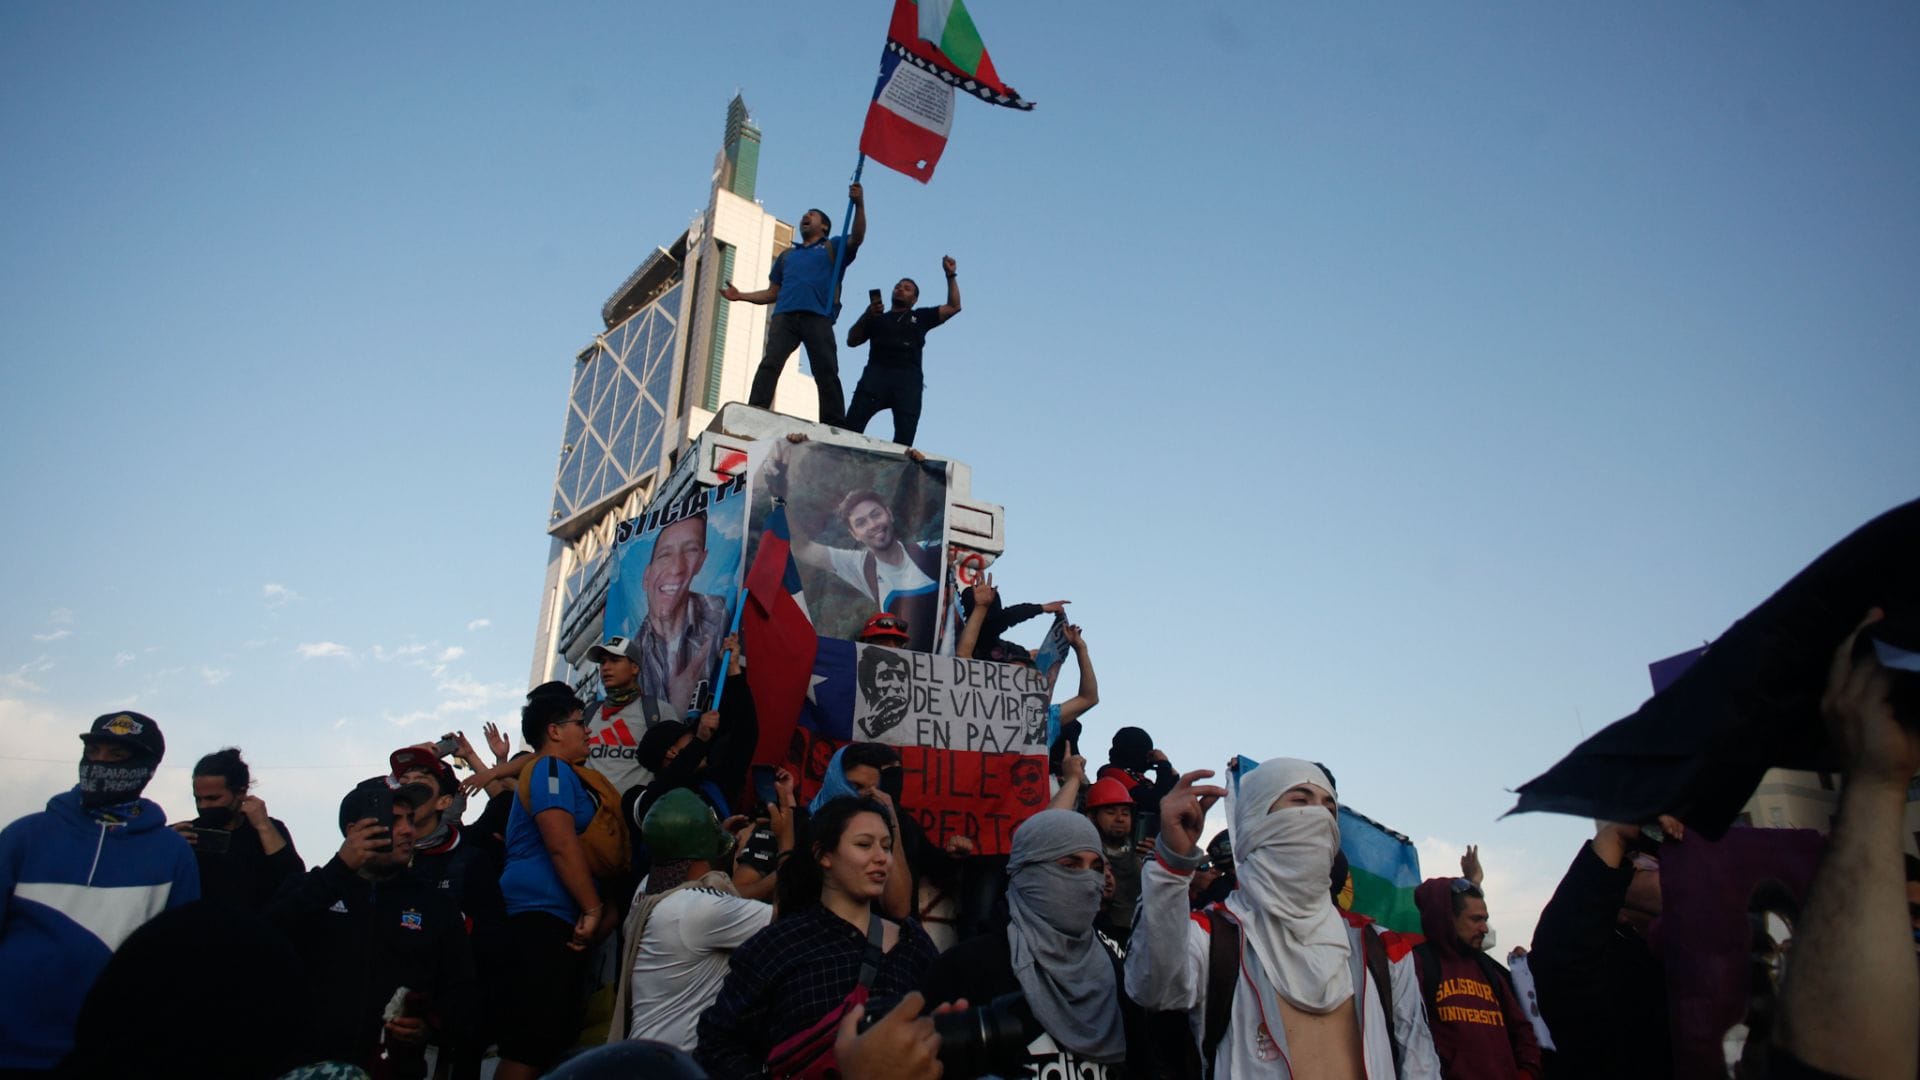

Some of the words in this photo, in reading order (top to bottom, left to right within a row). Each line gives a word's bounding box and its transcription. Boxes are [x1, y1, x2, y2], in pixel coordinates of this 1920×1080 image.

[613, 489, 710, 549] STICIA
[912, 652, 943, 684] EL
[952, 657, 1050, 692] DERECHO
[913, 685, 942, 716] DE
[588, 744, 640, 759] dida
[917, 718, 951, 750] EN
[966, 722, 1020, 755] PAZ
[898, 747, 1002, 799] HILE
[1436, 977, 1500, 1008] SALISBUR
